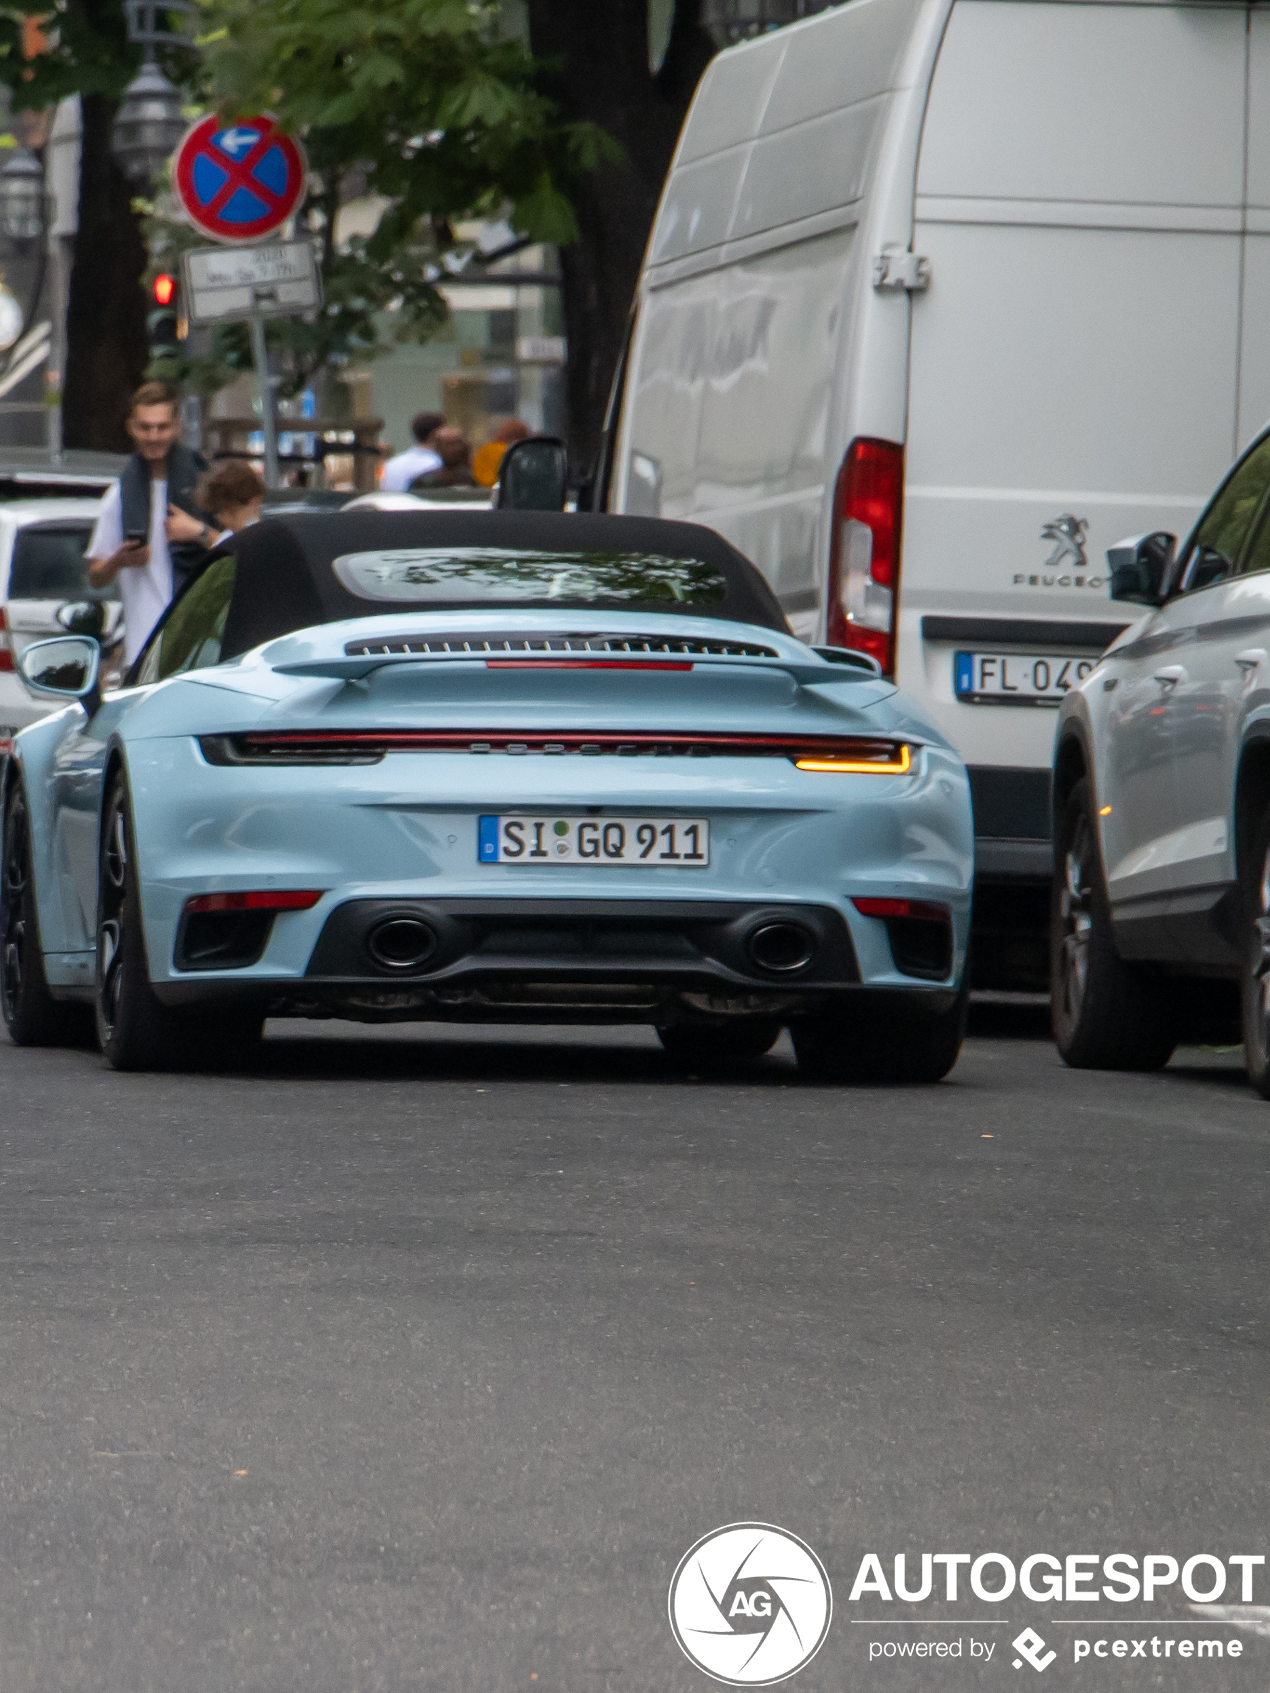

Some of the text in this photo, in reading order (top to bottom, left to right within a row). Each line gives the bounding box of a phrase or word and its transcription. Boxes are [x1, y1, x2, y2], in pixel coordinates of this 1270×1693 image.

[1013, 574, 1112, 588] PEUGEO
[980, 658, 1018, 691] FL
[503, 821, 705, 859] SI GQ 911
